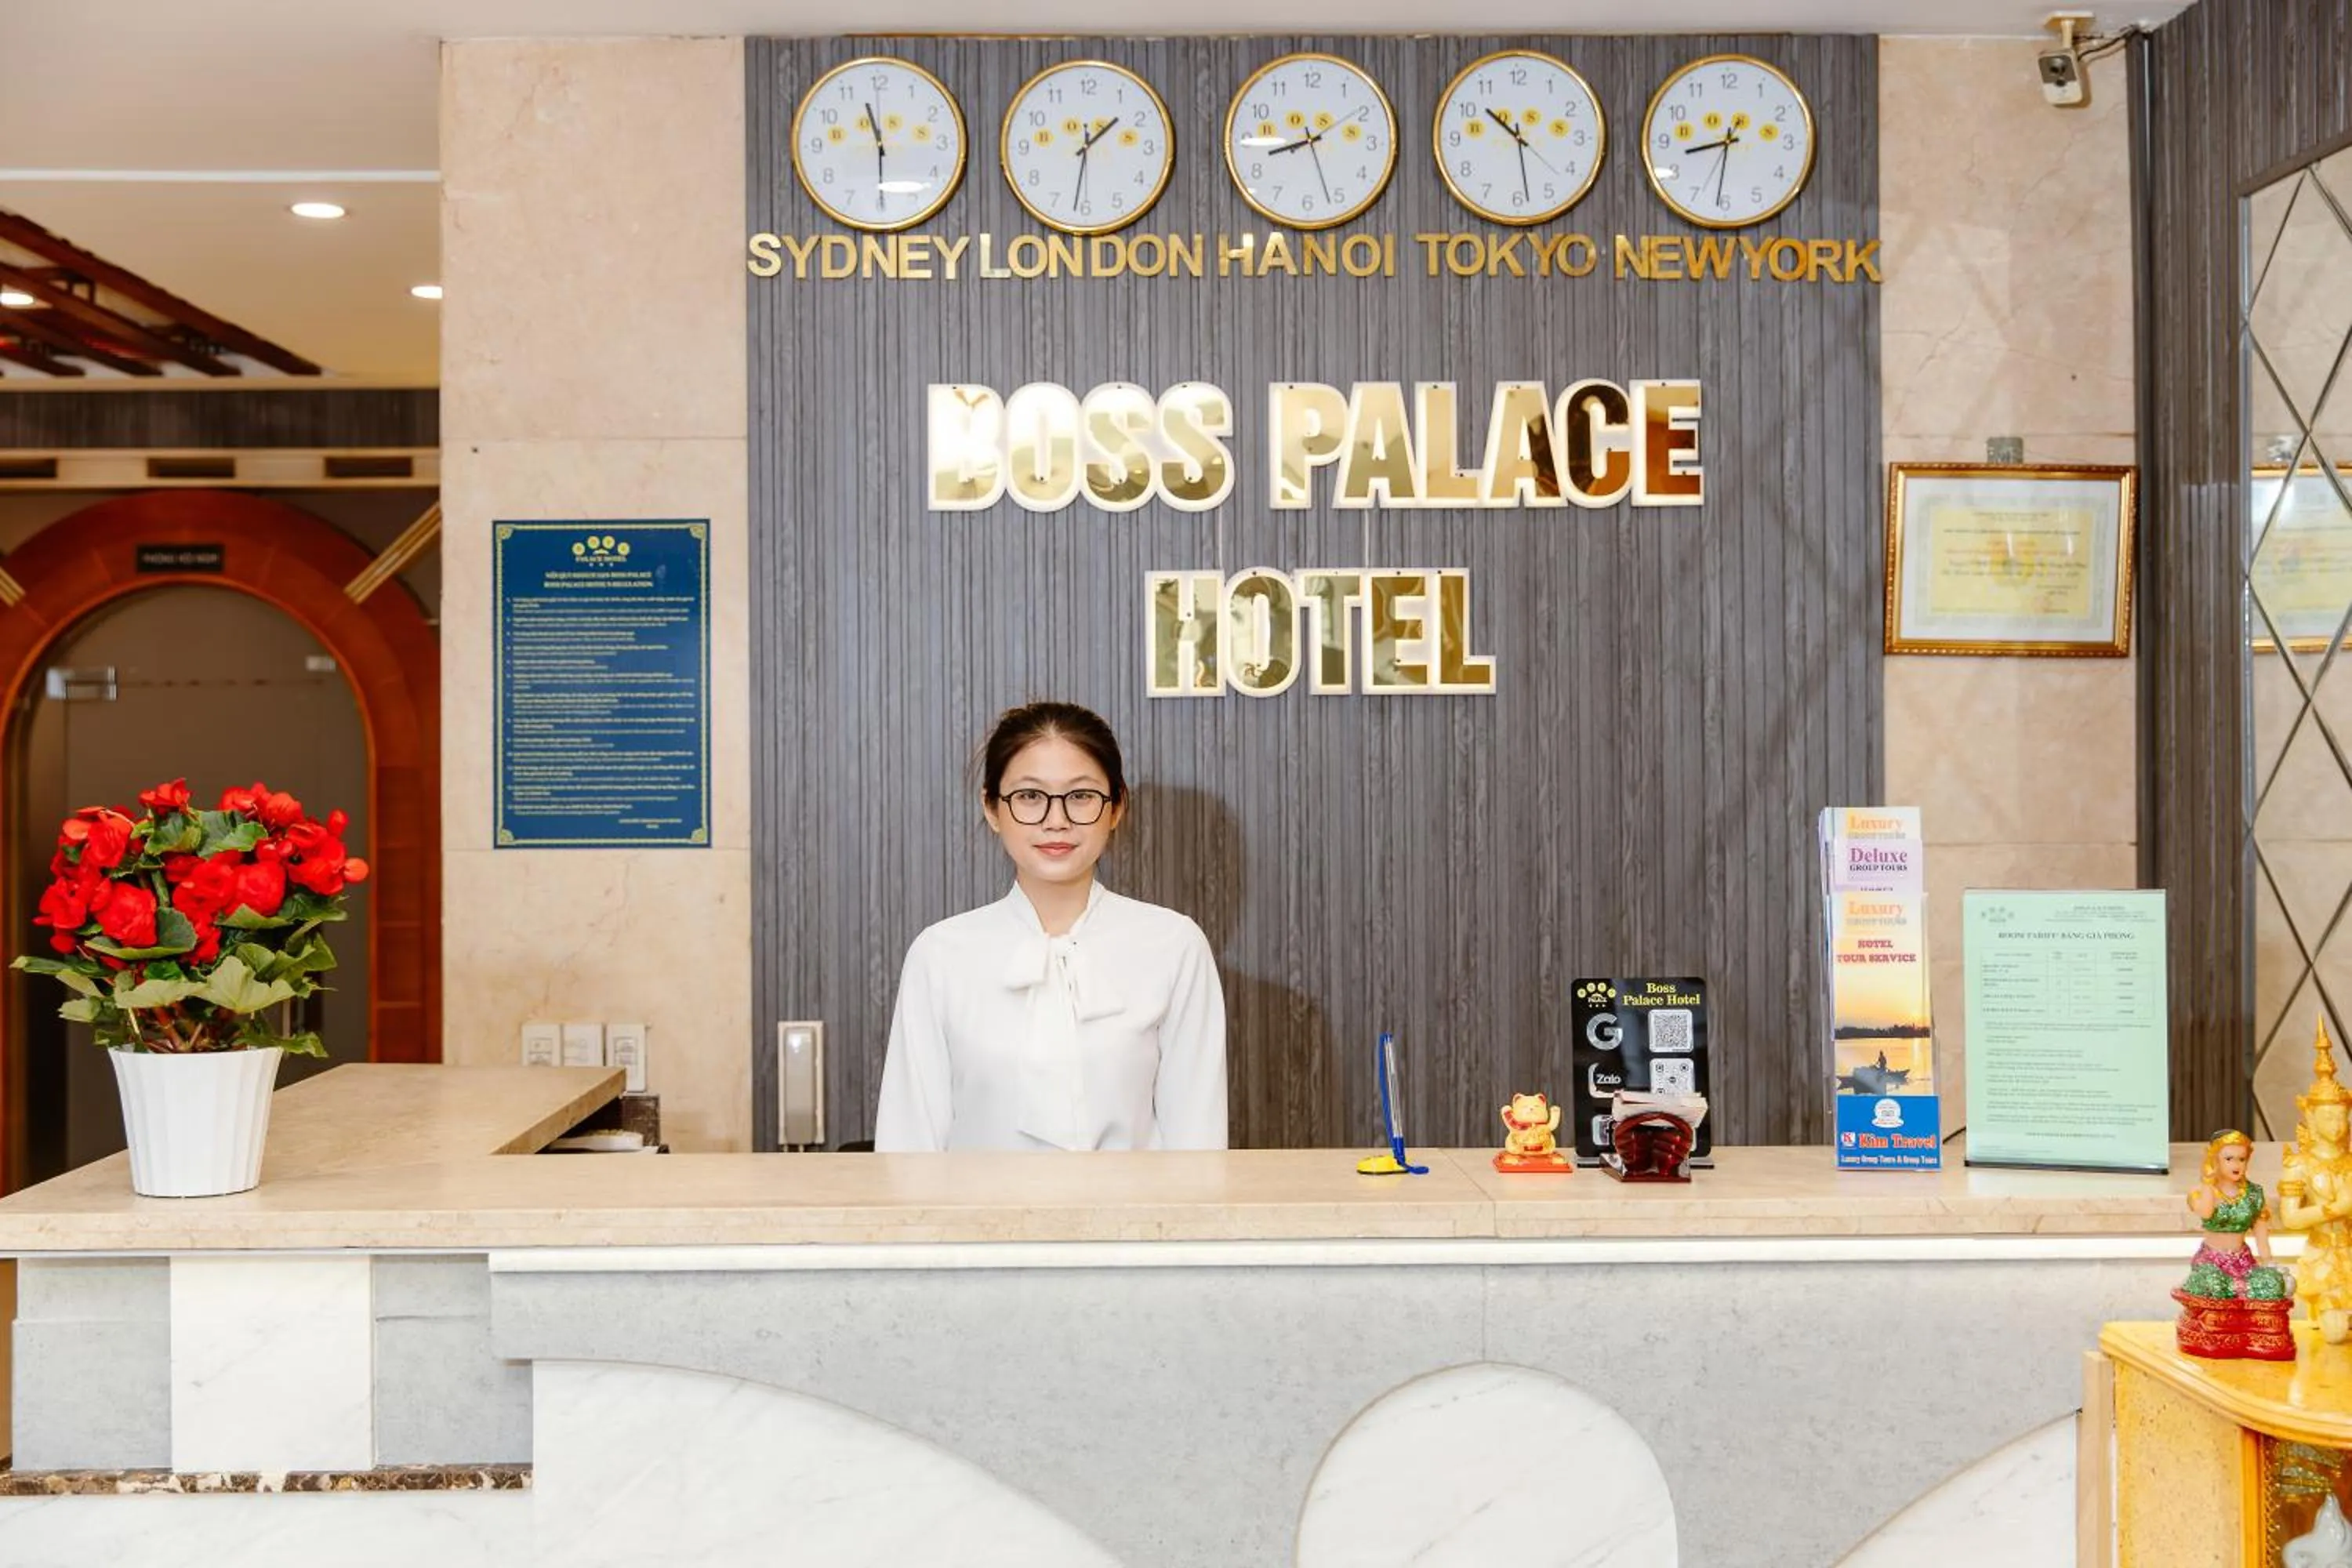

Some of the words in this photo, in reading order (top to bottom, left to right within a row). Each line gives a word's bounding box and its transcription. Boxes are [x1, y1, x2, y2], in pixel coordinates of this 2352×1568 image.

[870, 74, 889, 91] 12
[1304, 72, 1321, 89] 12
[1510, 70, 1526, 85] 12
[1721, 73, 1737, 89] 12
[840, 85, 853, 100] 11
[908, 85, 915, 99] 1
[1080, 78, 1098, 96] 12
[1272, 82, 1286, 96] 11
[1341, 83, 1347, 98] 1
[1479, 80, 1493, 95] 11
[1546, 80, 1552, 93] 1
[1689, 83, 1702, 97] 11
[1758, 83, 1762, 98] 1
[1048, 89, 1062, 103] 11
[1117, 89, 1123, 103] 1
[821, 108, 837, 124] 10
[927, 106, 938, 122] 2
[1253, 103, 1269, 119] 10
[1358, 105, 1370, 122] 2
[1460, 102, 1476, 118] 10
[1566, 101, 1577, 117] 2
[1669, 104, 1686, 121] 10
[1774, 106, 1786, 122] 2
[1029, 111, 1046, 126] 10
[1134, 111, 1146, 127] 2
[811, 138, 822, 153] 9
[936, 136, 949, 151] 3
[1367, 136, 1377, 151] 3
[1450, 132, 1461, 147] 9
[1573, 130, 1584, 146] 3
[1658, 133, 1669, 149] 9
[1783, 135, 1795, 150] 3
[1018, 140, 1029, 155] 9
[1143, 140, 1155, 155] 3
[823, 168, 834, 183] 8
[929, 165, 938, 178] 4
[1251, 162, 1262, 179] 8
[1356, 165, 1367, 180] 4
[1461, 162, 1472, 177] 8
[1566, 161, 1575, 175] 4
[1773, 165, 1784, 180] 4
[1029, 169, 1040, 186] 8
[1134, 170, 1144, 185] 4
[845, 189, 855, 204] 7
[1272, 186, 1283, 201] 7
[1334, 187, 1345, 204] 5
[1482, 183, 1492, 199] 7
[1544, 183, 1555, 199] 5
[1689, 186, 1700, 201] 7
[1751, 187, 1762, 203] 5
[1049, 192, 1061, 208] 7
[1112, 193, 1123, 209] 5
[1302, 195, 1313, 211] 6
[1512, 191, 1523, 207] 6
[1719, 195, 1730, 211] 6
[1080, 200, 1091, 216] 6
[747, 233, 971, 280] SYDNEY
[979, 232, 1203, 278] LONDON
[1218, 231, 1395, 277] HANOI
[1416, 233, 1596, 278] TOKYO
[927, 381, 1236, 514] BOSS
[1269, 379, 1705, 510] PALACE
[1145, 566, 1497, 698] HOTEL
[1849, 848, 1907, 863] Deluxe
[1849, 901, 1904, 916] Luxury
[1857, 940, 1893, 949] HOTEL
[1837, 953, 1866, 964] TOUR
[1869, 953, 1917, 963] SERVICE
[1646, 982, 1676, 993] Boss
[1622, 994, 1664, 1006] Palace
[1667, 994, 1701, 1005] Hotel
[1586, 1012, 1624, 1051] G
[1596, 1074, 1622, 1085] Zalo
[1859, 1133, 1888, 1149] Kim
[1891, 1133, 1936, 1149] Travel
